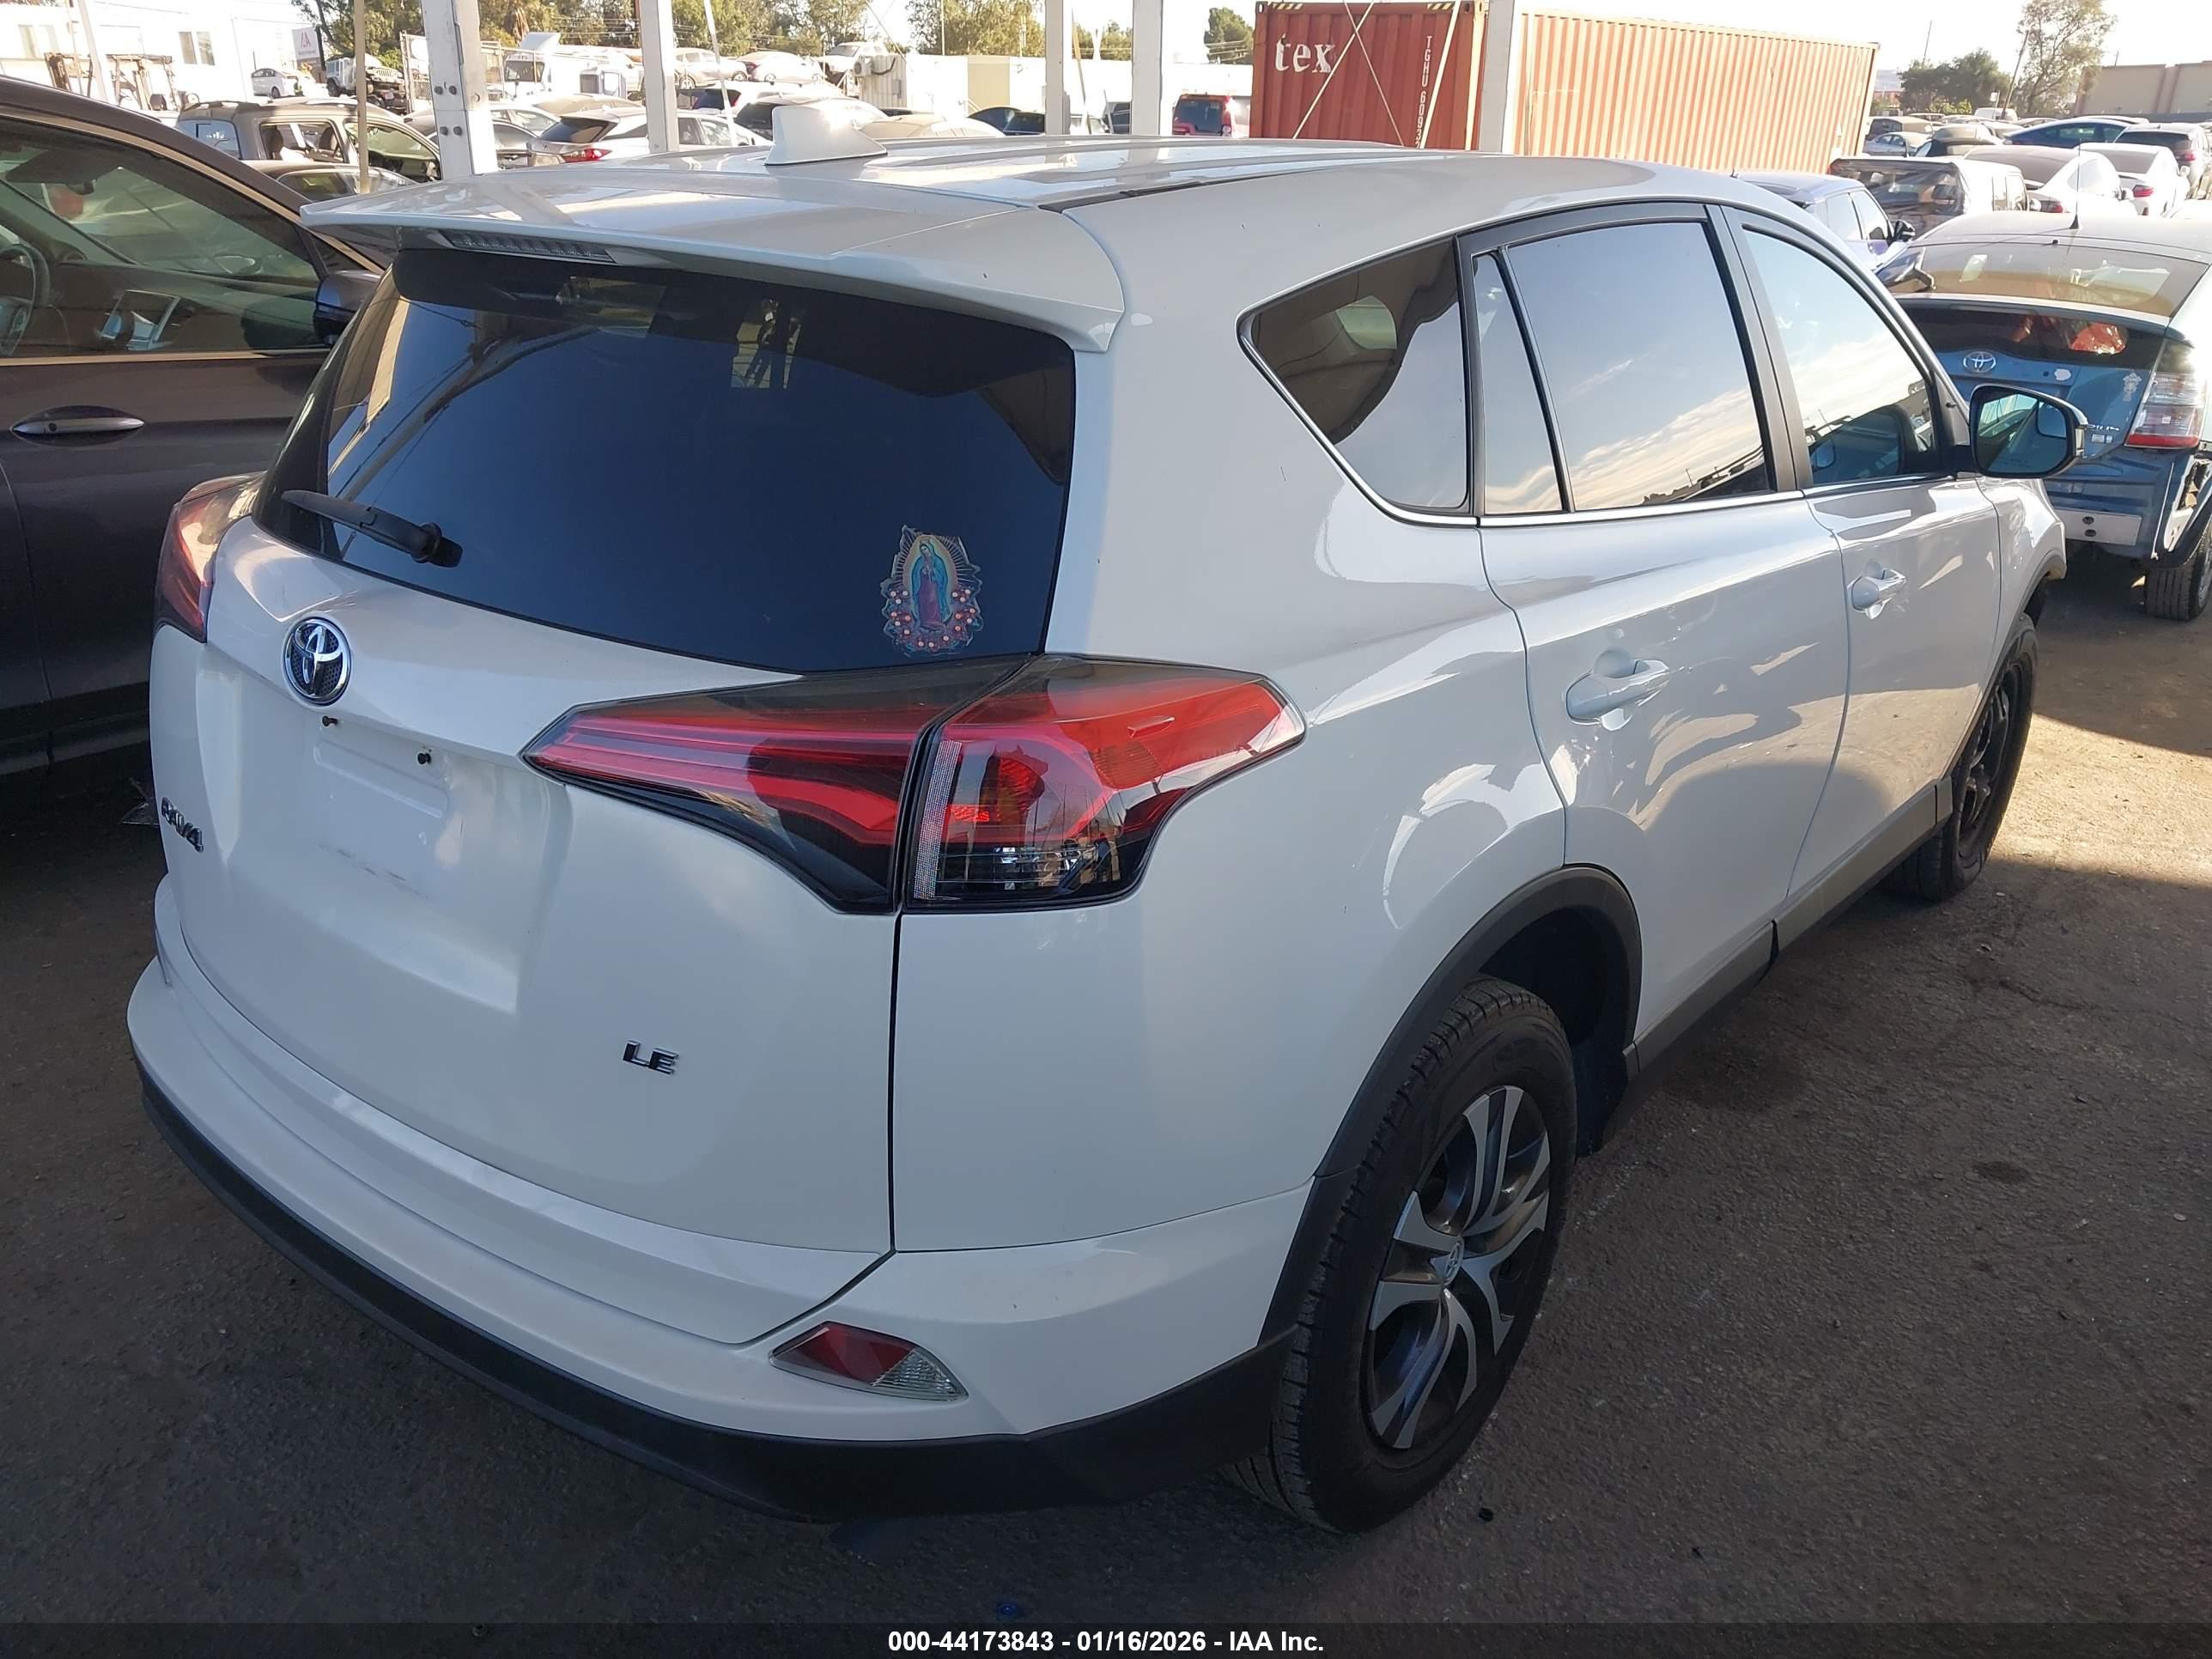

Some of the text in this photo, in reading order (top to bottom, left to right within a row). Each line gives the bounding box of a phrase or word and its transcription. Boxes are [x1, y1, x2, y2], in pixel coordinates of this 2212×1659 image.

[1275, 33, 1335, 73] tex
[1421, 35, 1433, 88] TGHU
[623, 1040, 679, 1075] LE
